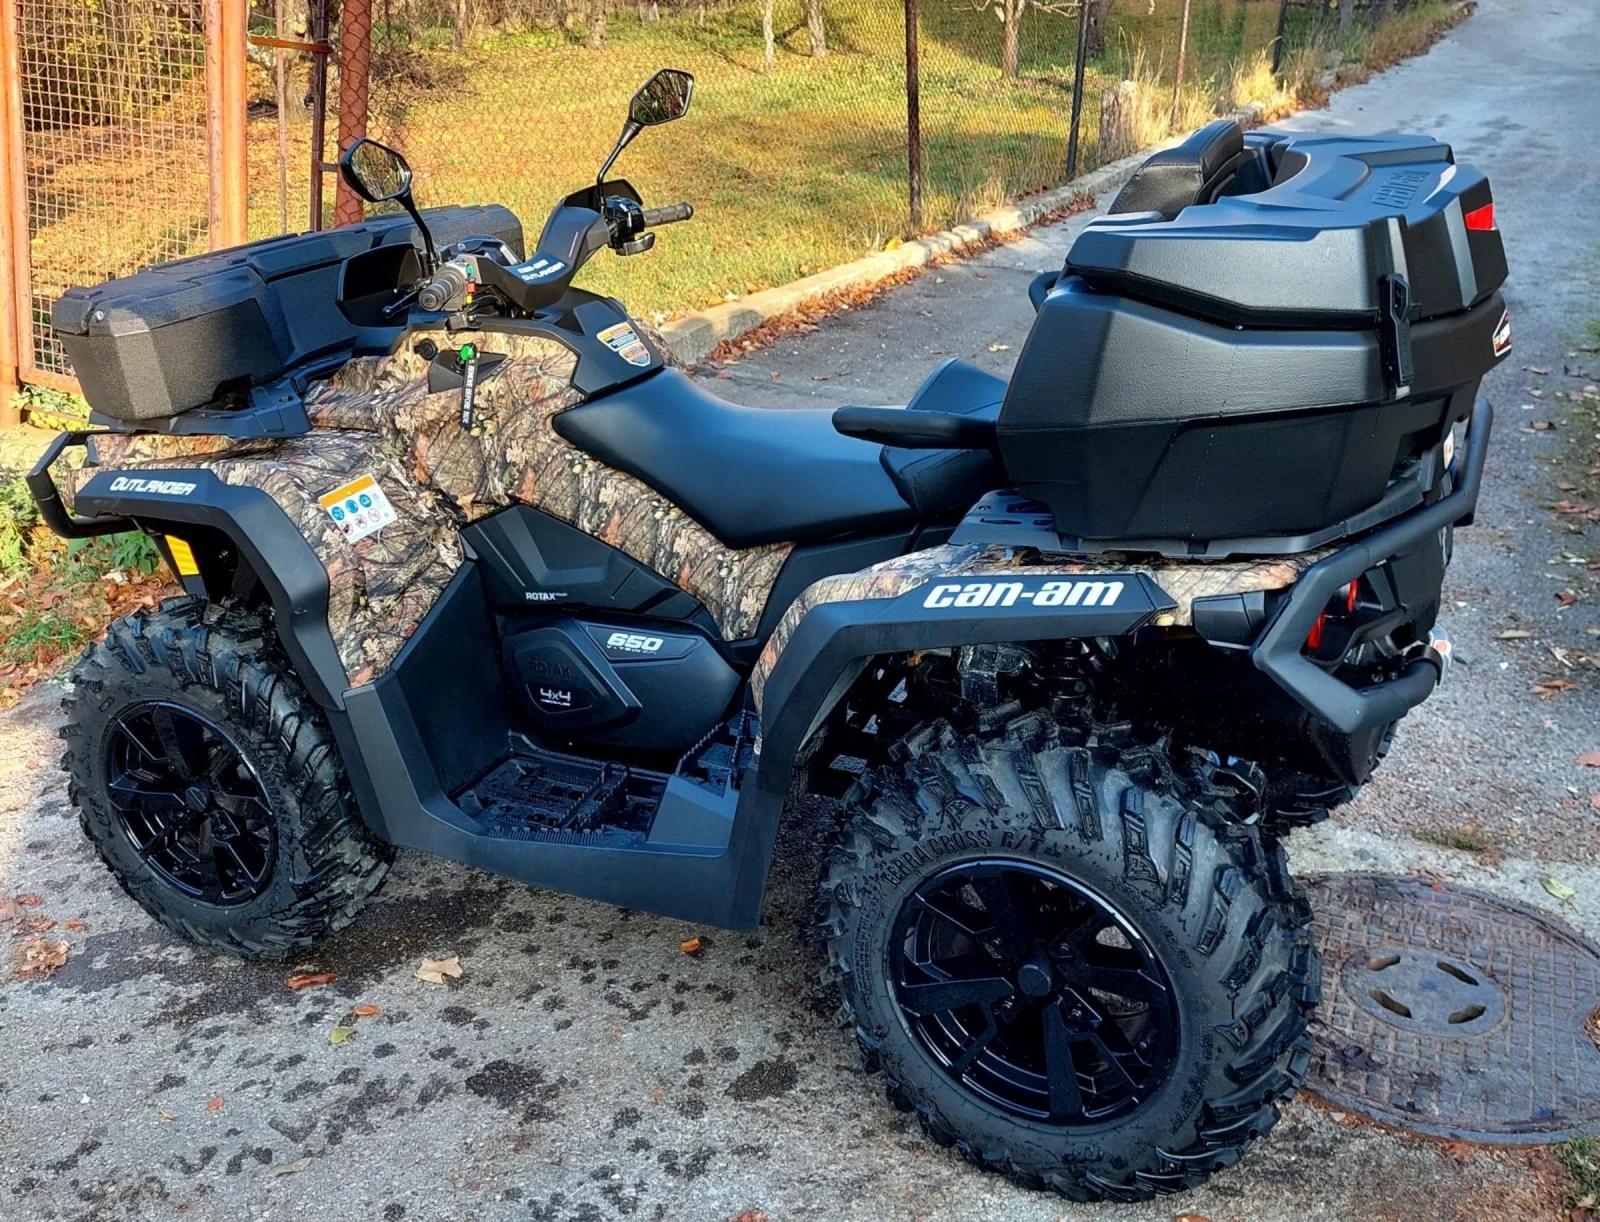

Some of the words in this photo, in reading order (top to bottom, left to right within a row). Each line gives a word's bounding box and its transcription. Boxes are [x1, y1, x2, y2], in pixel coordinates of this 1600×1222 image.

[109, 476, 197, 496] OUTLANDER
[525, 592, 556, 601] ROTAX
[922, 581, 1125, 609] can-am
[607, 632, 664, 651] 650
[540, 688, 571, 702] 4x4
[882, 845, 933, 889] TERRA
[929, 829, 992, 856] CROSS
